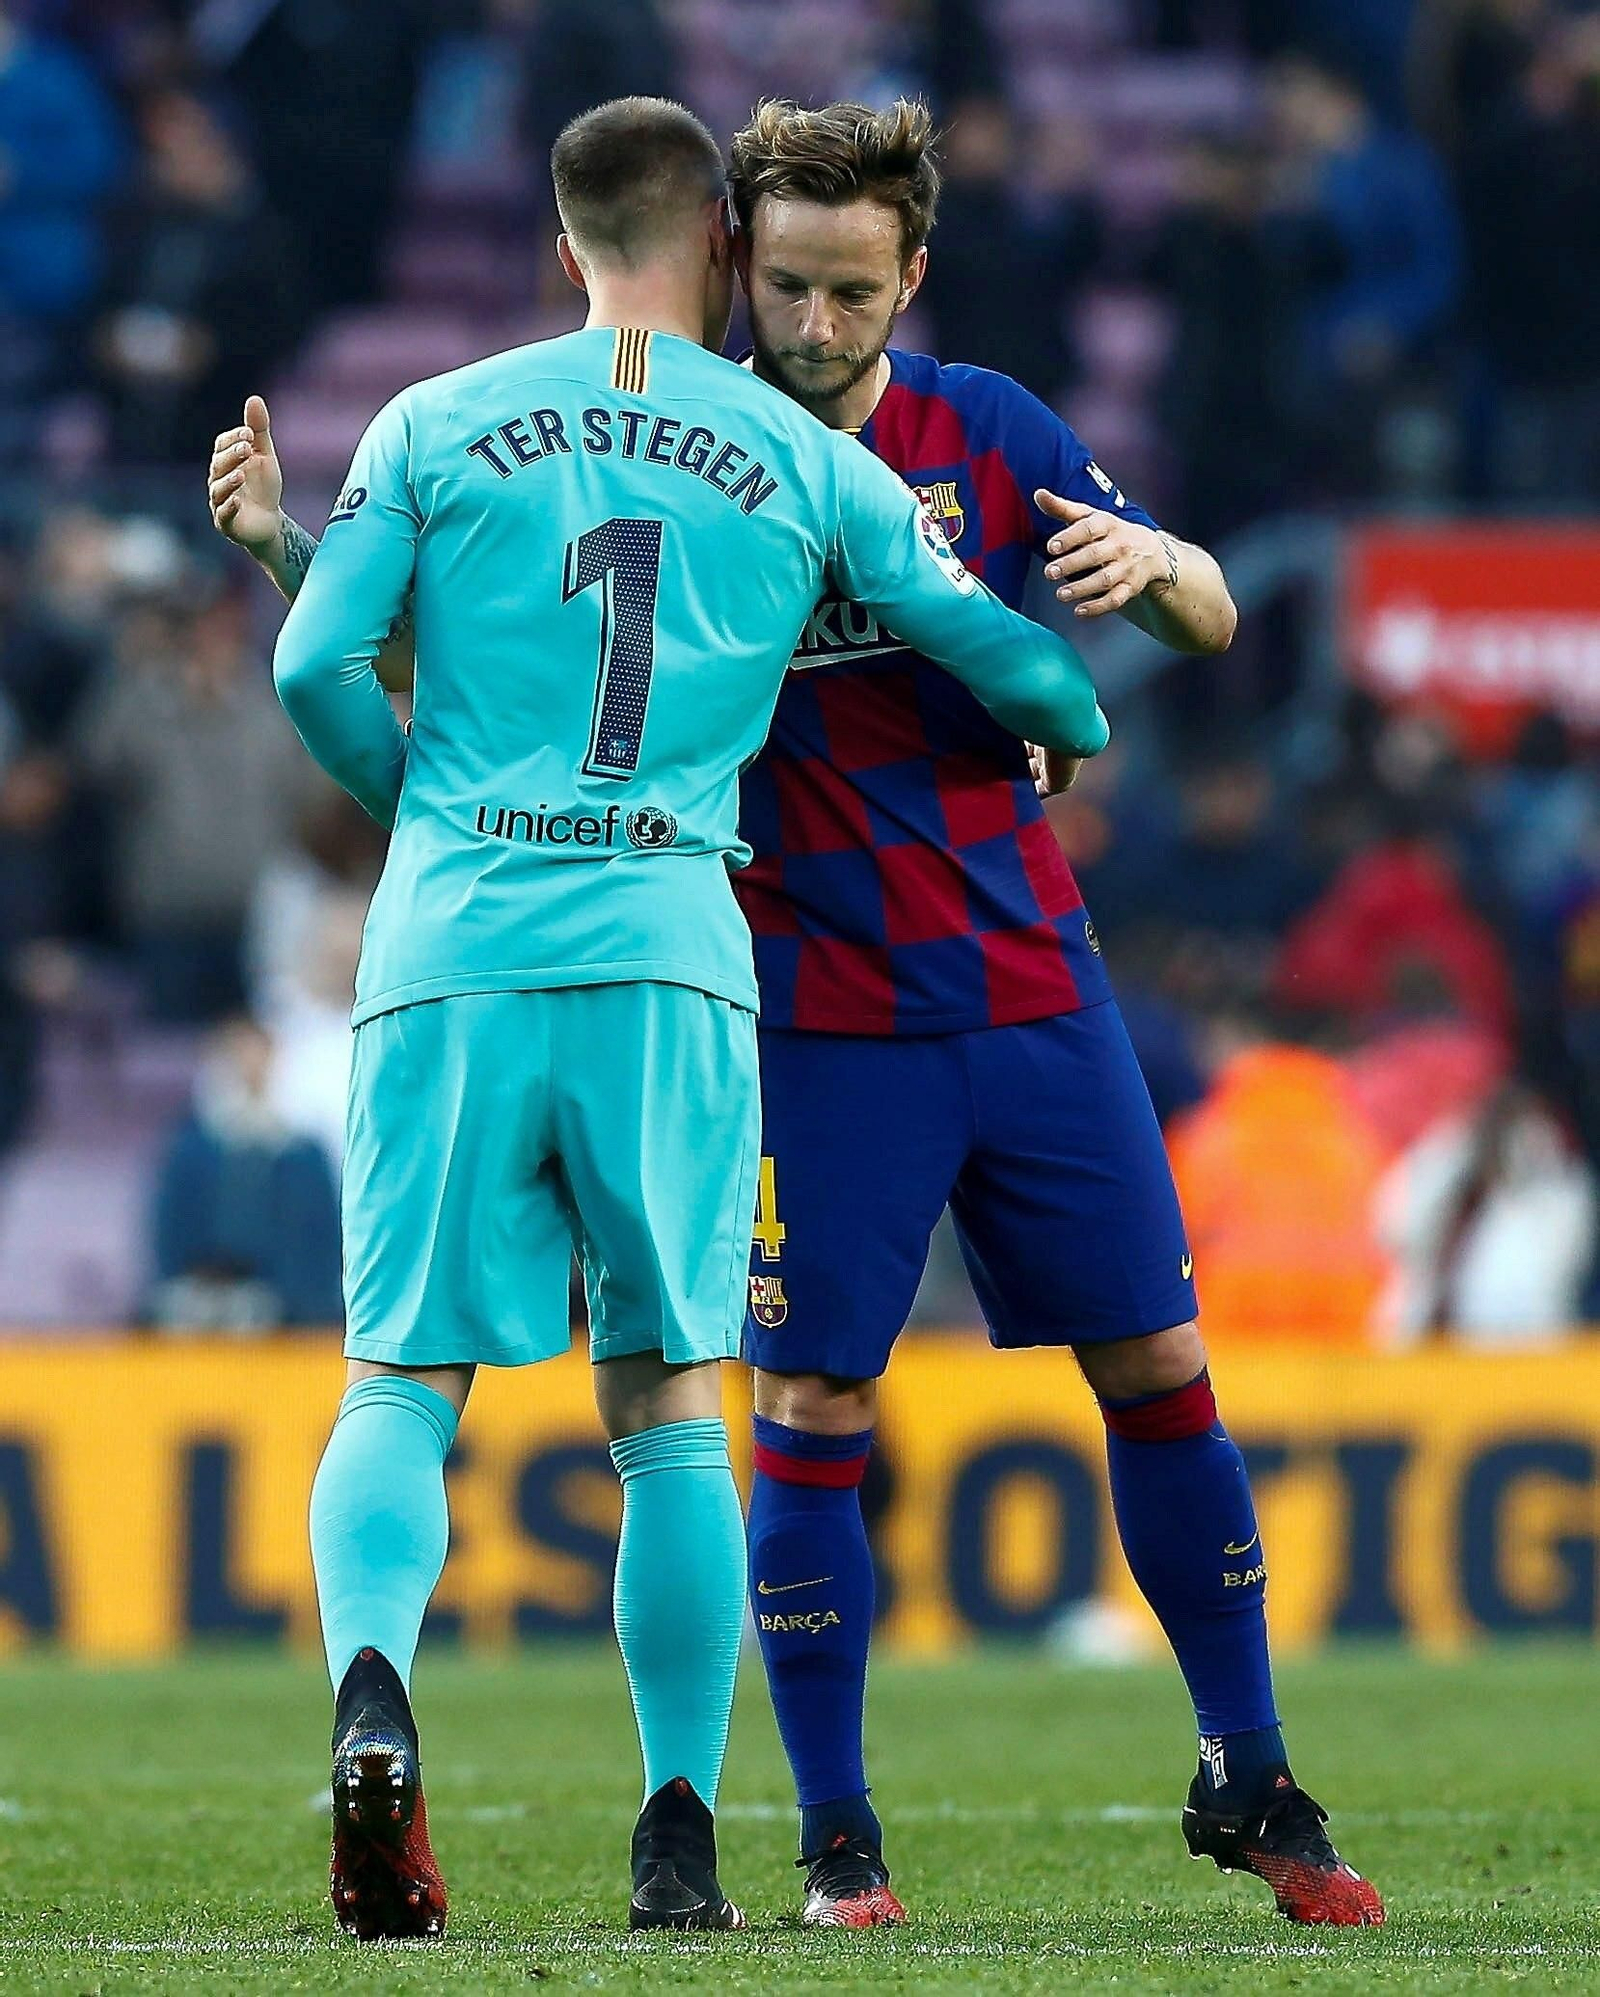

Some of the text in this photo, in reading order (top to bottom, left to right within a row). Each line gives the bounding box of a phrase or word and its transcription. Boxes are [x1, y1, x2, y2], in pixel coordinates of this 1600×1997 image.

[466, 408, 779, 516] TER STEGEN
[560, 517, 664, 783] 1
[476, 803, 621, 848] unicef
[752, 1156, 787, 1262] 4
[759, 1610, 841, 1634] BARÇA
